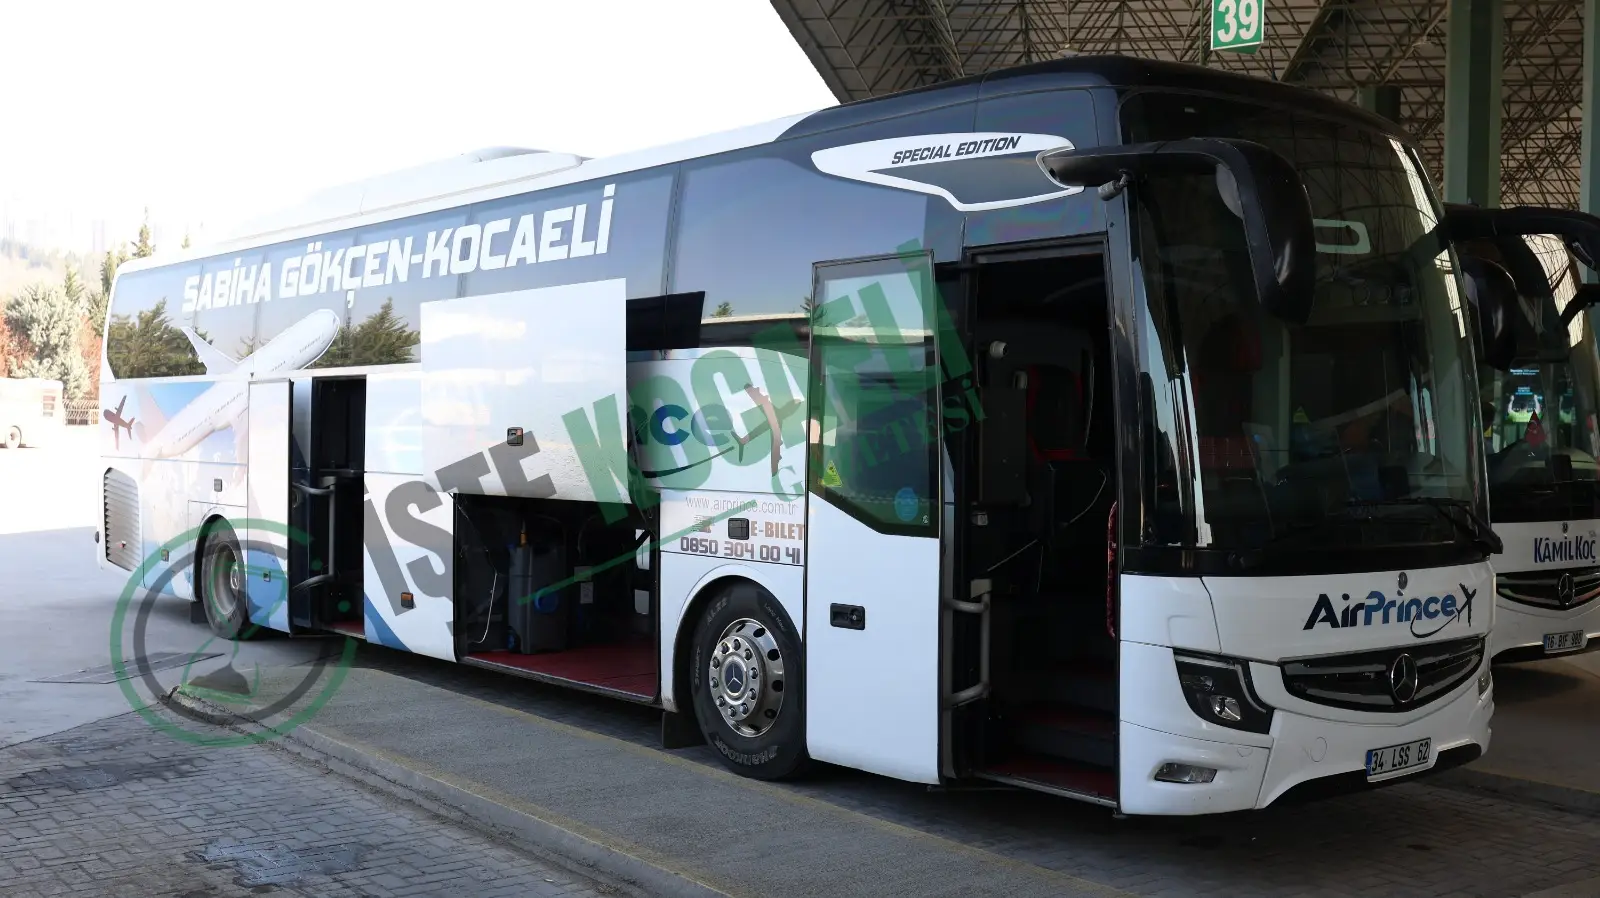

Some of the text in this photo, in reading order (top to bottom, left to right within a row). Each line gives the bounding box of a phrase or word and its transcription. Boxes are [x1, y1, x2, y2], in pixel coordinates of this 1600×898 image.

[1217, 0, 1259, 42] 39
[891, 135, 1021, 165] SPECIAL EDITION
[181, 255, 271, 313] SABİHA
[680, 537, 801, 564] 0850 304 00 41
[1372, 741, 1428, 771] 34 LSS 62
